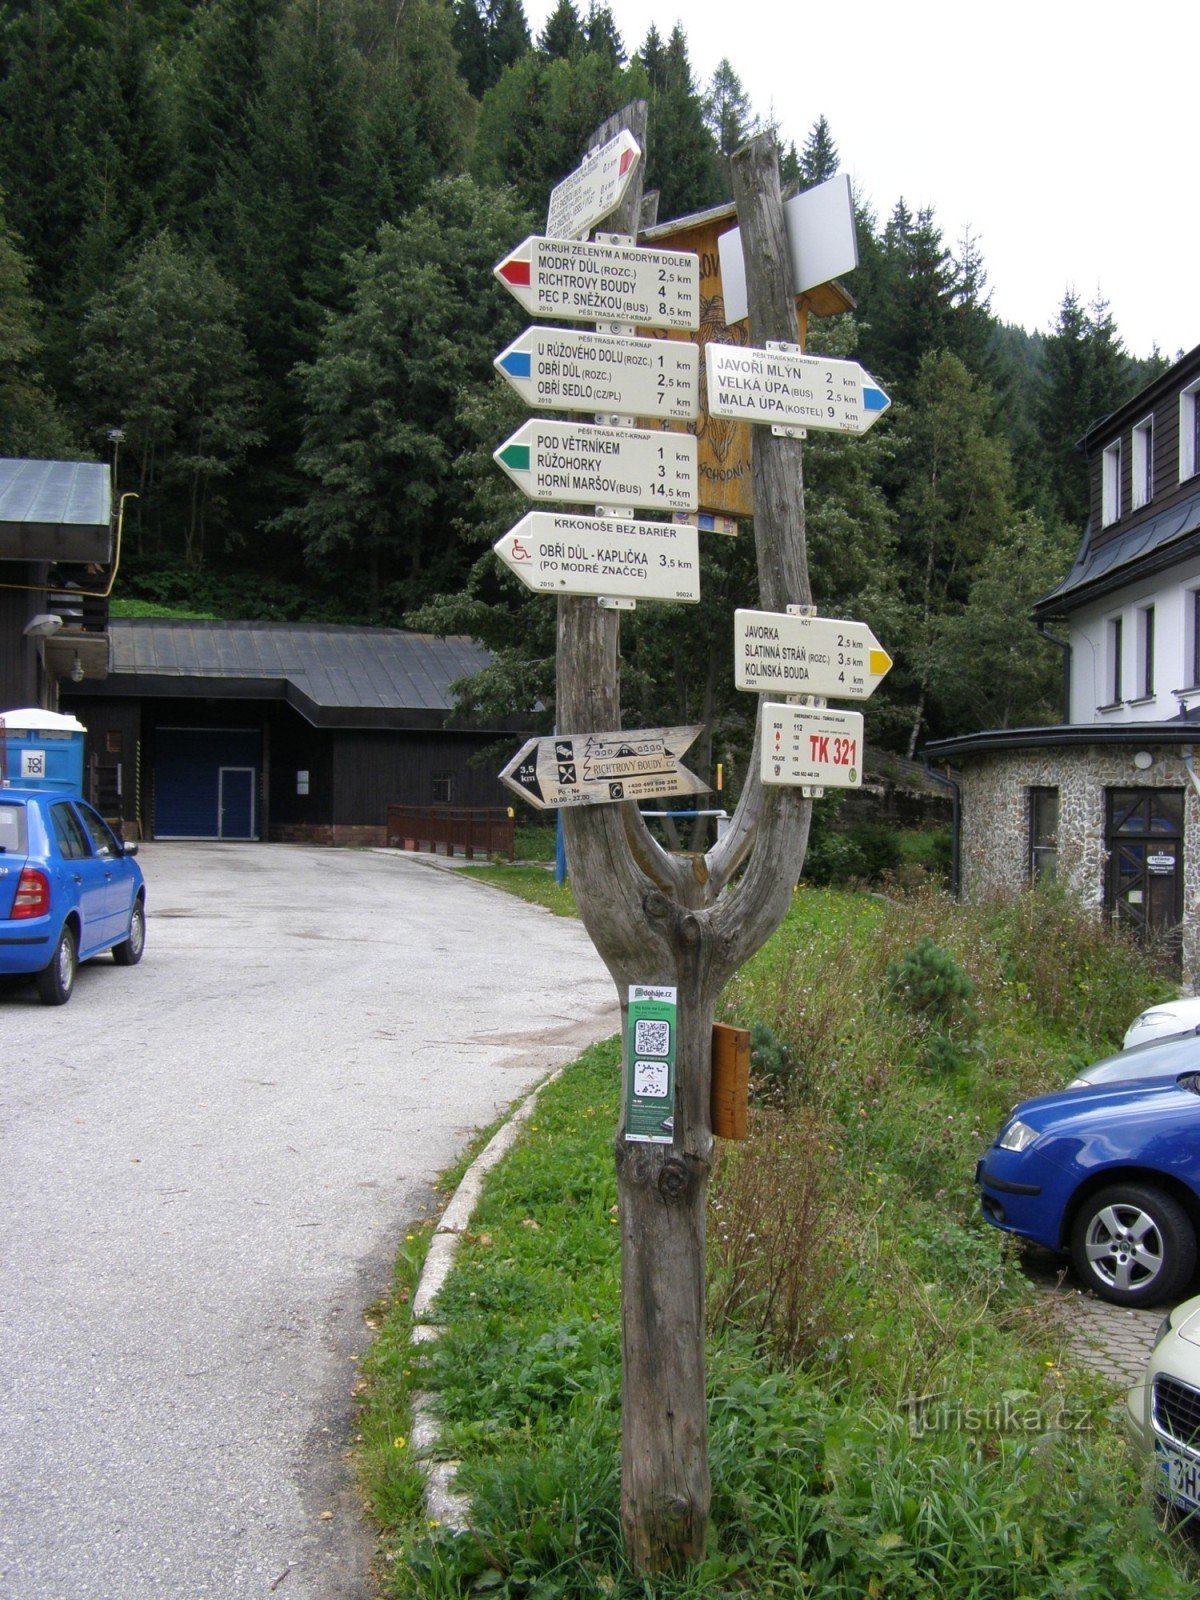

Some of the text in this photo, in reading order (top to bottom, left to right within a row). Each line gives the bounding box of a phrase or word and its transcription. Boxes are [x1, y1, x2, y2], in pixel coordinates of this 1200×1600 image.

[538, 243, 569, 253] OKRUH
[572, 246, 612, 258] ZELENÝM
[622, 252, 659, 264] MODRÝM
[662, 257, 691, 267] DOLEM
[539, 256, 576, 271] MODRÝ
[580, 258, 599, 274] DŮL
[658, 269, 674, 282] 2,5
[678, 275, 691, 283] km
[539, 273, 691, 300] RICHTROVY BOUDY 4 km
[539, 290, 691, 317] PEC P. SNĚŽKOU (BUS) 8,5 km
[538, 343, 544, 356] U
[547, 341, 596, 360] RŮŽOVÉHO
[599, 349, 623, 363] DOLU
[658, 355, 664, 367] 1
[677, 361, 690, 370] km
[538, 361, 560, 376] OBŘÍ
[563, 362, 580, 377] DŮL
[658, 374, 674, 387] 2,5
[677, 379, 690, 388] km
[717, 358, 856, 386] JAVOŘÍ MLÝN 2 km
[538, 380, 560, 395] OBŘÍ
[562, 383, 592, 398] SEDLO
[657, 392, 664, 404] 7
[677, 398, 690, 406] km
[718, 375, 857, 403] VELKÁ ÚPA (BUS) 2,5 km
[719, 393, 858, 421] MALÁ ÚPA (KOSTEL) 9 km
[538, 435, 690, 462] POD VĚTRNÍKEM 1 km
[616, 432, 651, 440] KČT-KRNAP
[538, 452, 690, 480] RŮŽOHORKY 3 km
[538, 473, 570, 488] HORNÍ
[650, 483, 674, 497] 14,5
[677, 489, 690, 498] km
[555, 519, 677, 538] KRKONOŠE BEZ BARIÉR
[540, 543, 565, 558] OBŘÍ
[568, 544, 588, 560] DŮL
[597, 549, 648, 565] KAPLIČKA
[659, 555, 675, 568] 3,5
[678, 560, 692, 568] km
[540, 561, 647, 579] (PO MODRÉ ZNAČCE)
[745, 625, 863, 648] JAVORKA 2,5 km
[745, 644, 780, 659] SLATINNÁ
[782, 646, 806, 661] STRÁŇ
[838, 653, 851, 666] 3,5
[853, 658, 863, 666] km
[745, 661, 863, 684] KOLÍNSKÁ BOUDA 4 km
[810, 735, 856, 766] TK 321
[520, 766, 534, 774] 3,5
